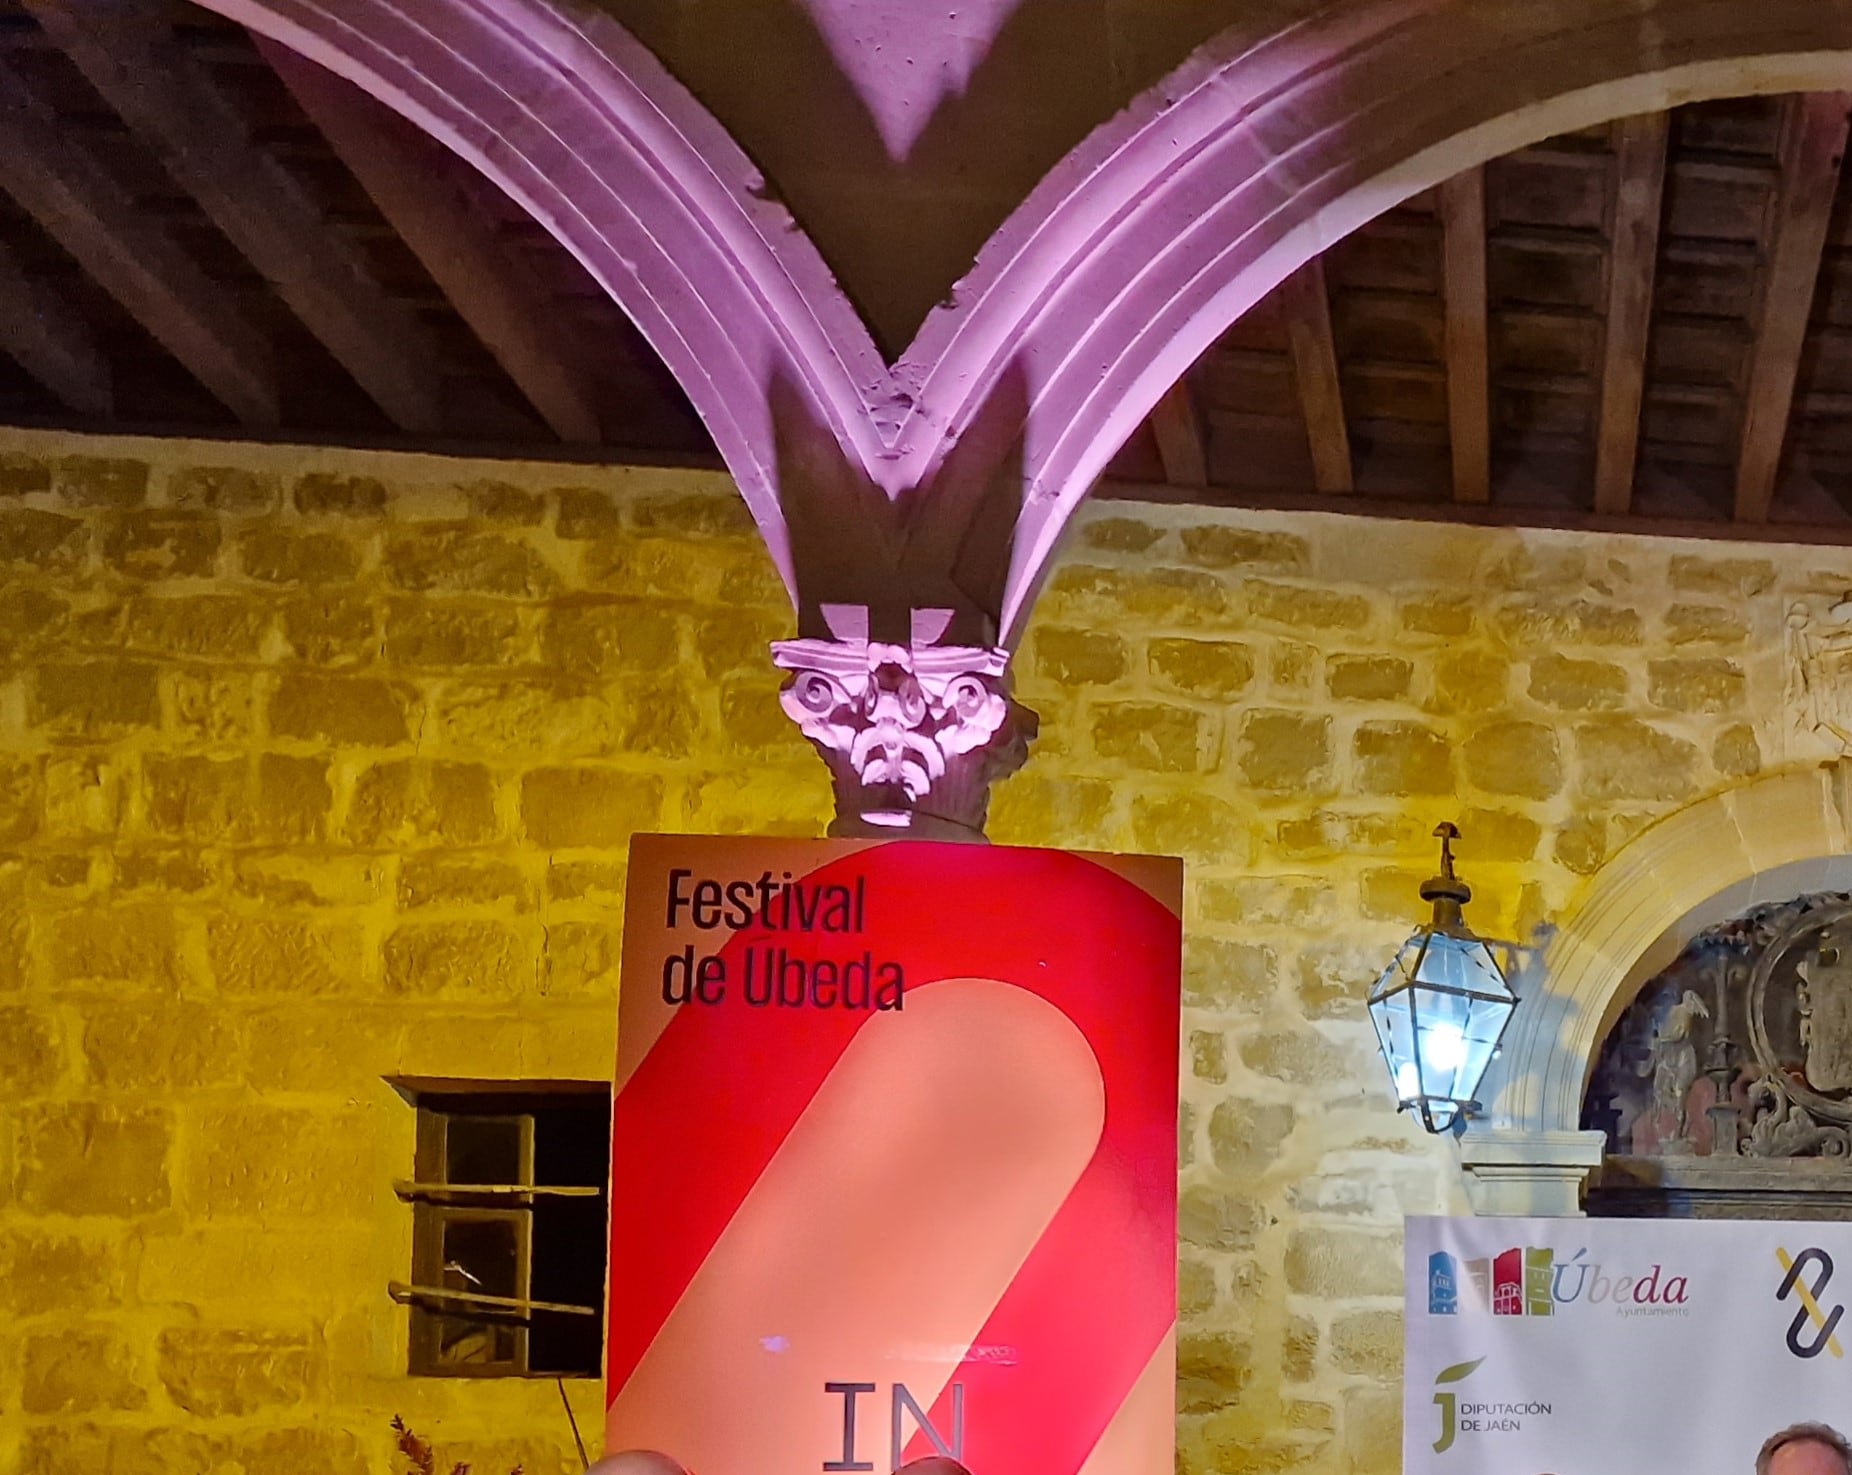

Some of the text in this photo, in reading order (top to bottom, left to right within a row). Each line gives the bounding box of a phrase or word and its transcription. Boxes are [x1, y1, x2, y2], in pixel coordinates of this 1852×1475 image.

[666, 869, 865, 933] Festival
[662, 935, 905, 1011] de Úbeda
[1552, 1247, 1689, 1304] Úbeda
[1616, 1307, 1690, 1318] Ayuntamiento
[822, 1382, 964, 1473] IN
[1461, 1401, 1552, 1415] DIPUTACIÓN
[1461, 1418, 1520, 1431] DE JAÉN
